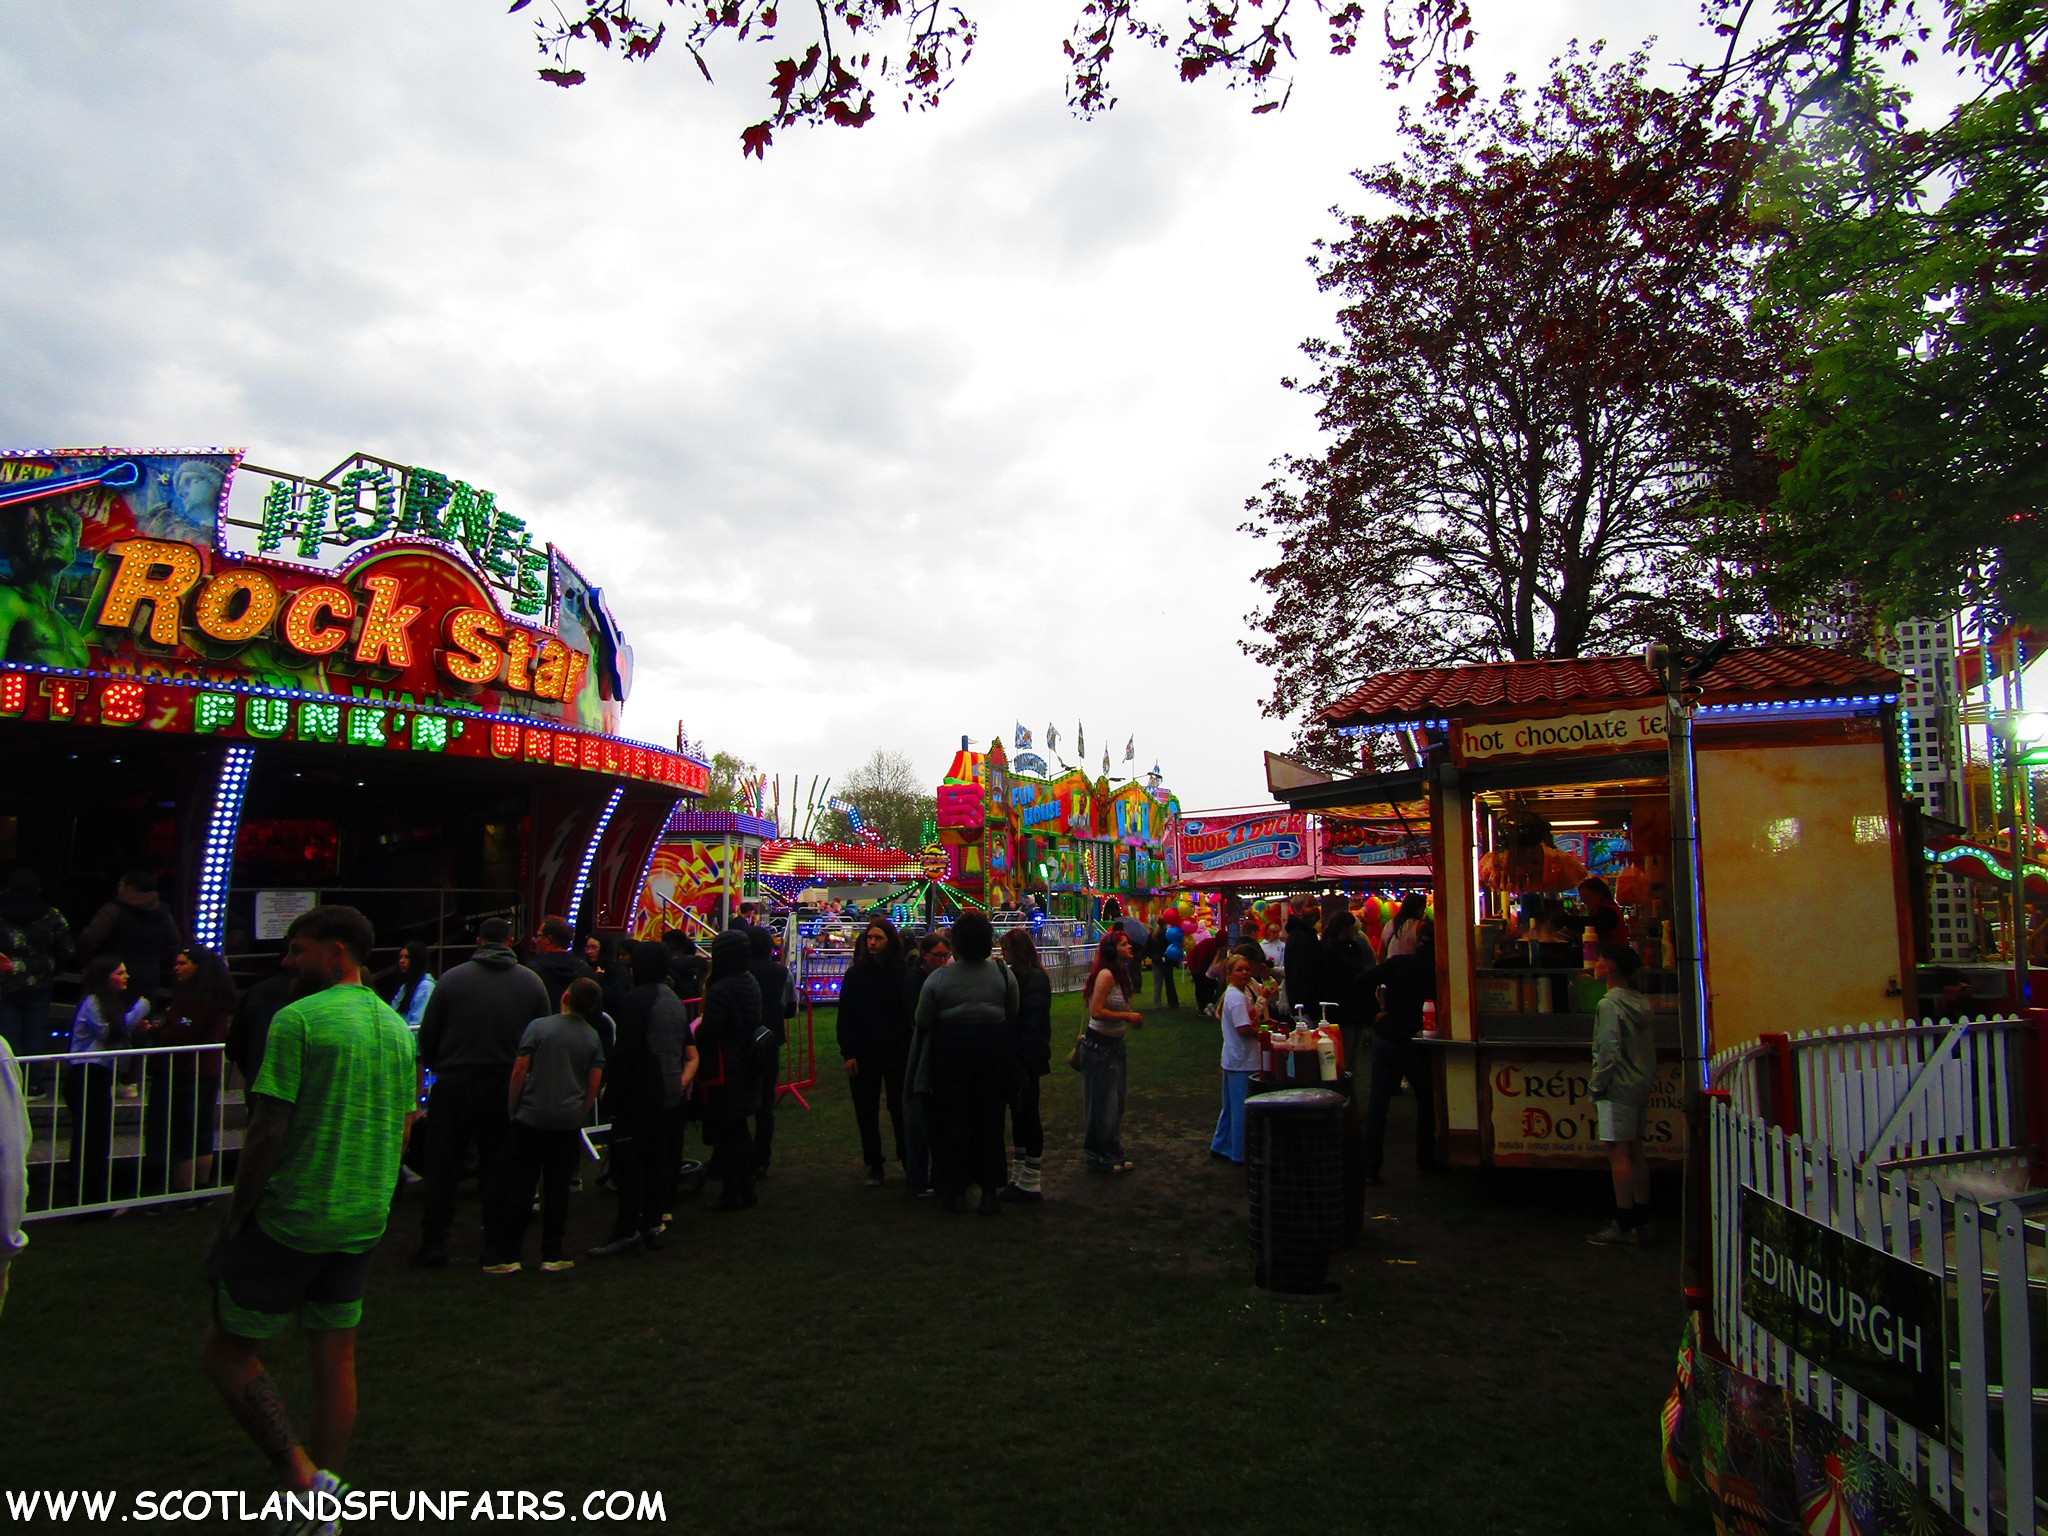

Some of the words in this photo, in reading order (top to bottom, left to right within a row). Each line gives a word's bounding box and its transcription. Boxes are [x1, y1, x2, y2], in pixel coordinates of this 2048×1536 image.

[97, 536, 423, 669] Rock
[444, 606, 589, 704] Star
[1464, 731, 1504, 752] hot
[1515, 719, 1627, 748] chocolate
[1638, 715, 1667, 736] te
[1012, 784, 1036, 807] FUN
[1024, 800, 1061, 827] HOUSE
[1183, 829, 1231, 857] HOOK
[1233, 827, 1246, 846] A
[1250, 813, 1303, 841] DUCK
[1203, 855, 1224, 870] PRIZE
[1225, 849, 1250, 865] EVERY
[1251, 845, 1273, 858] TIME
[1359, 850, 1391, 864] PRIZE
[1495, 1065, 1589, 1105] Crép
[1646, 1095, 1684, 1109] inks
[1750, 1236, 1923, 1373] EDINBURGH
